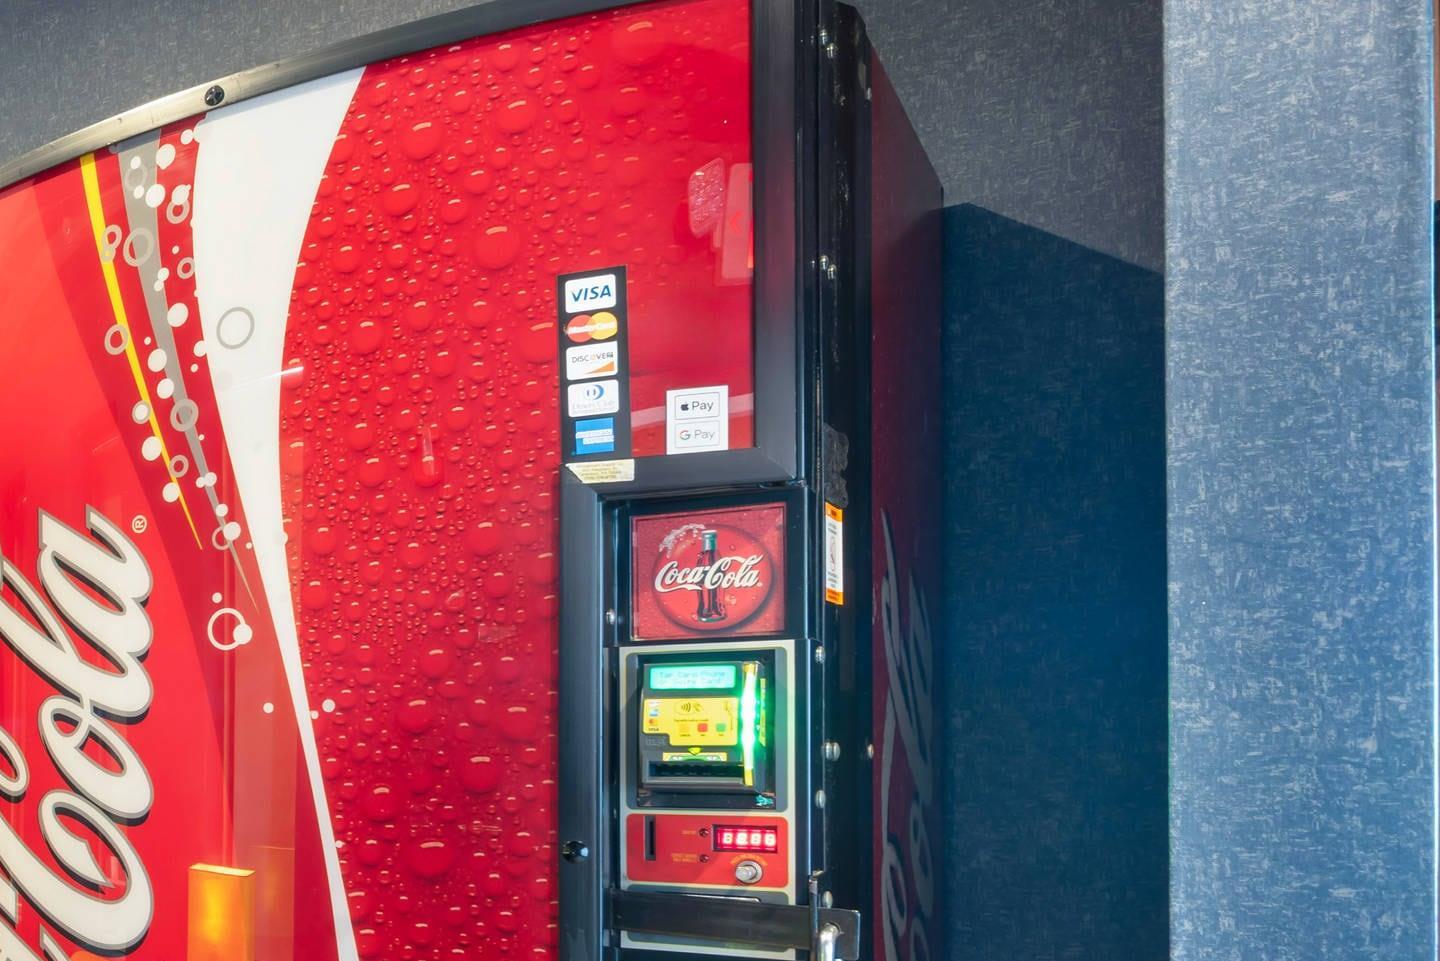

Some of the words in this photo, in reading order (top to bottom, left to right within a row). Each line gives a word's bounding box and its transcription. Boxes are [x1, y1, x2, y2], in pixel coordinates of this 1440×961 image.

[571, 285, 612, 302] VISA
[691, 400, 714, 413] Pay
[693, 429, 716, 442] Pay
[655, 553, 763, 593] Coca-Cola
